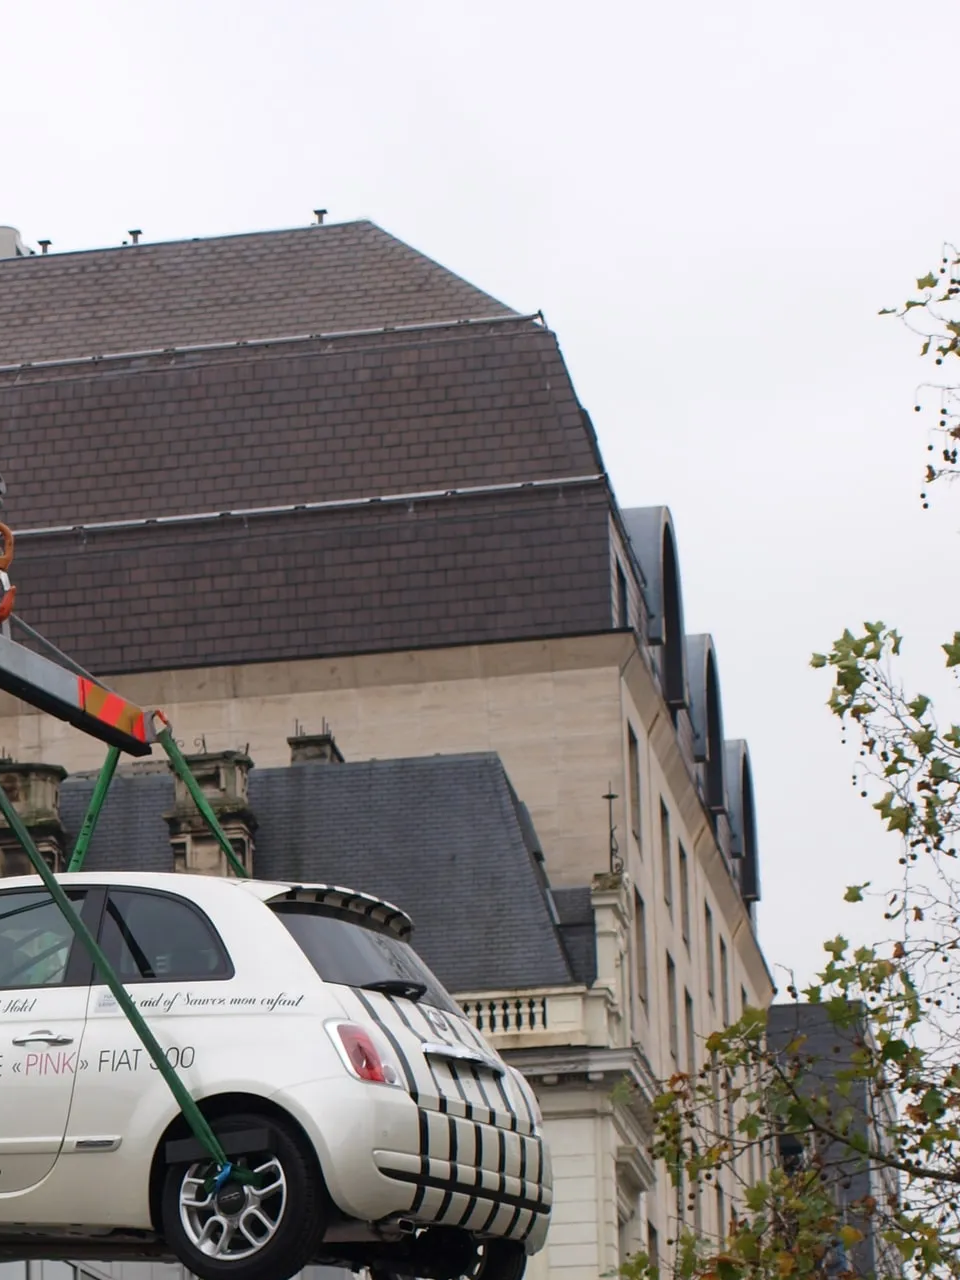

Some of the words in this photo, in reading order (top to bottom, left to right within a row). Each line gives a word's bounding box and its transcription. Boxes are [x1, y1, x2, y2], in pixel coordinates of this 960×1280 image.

[2, 998, 38, 1013] Hotel
[163, 992, 182, 1012] of
[229, 997, 257, 1006] mon
[260, 992, 305, 1012] enfant
[98, 1049, 143, 1072] FIAT
